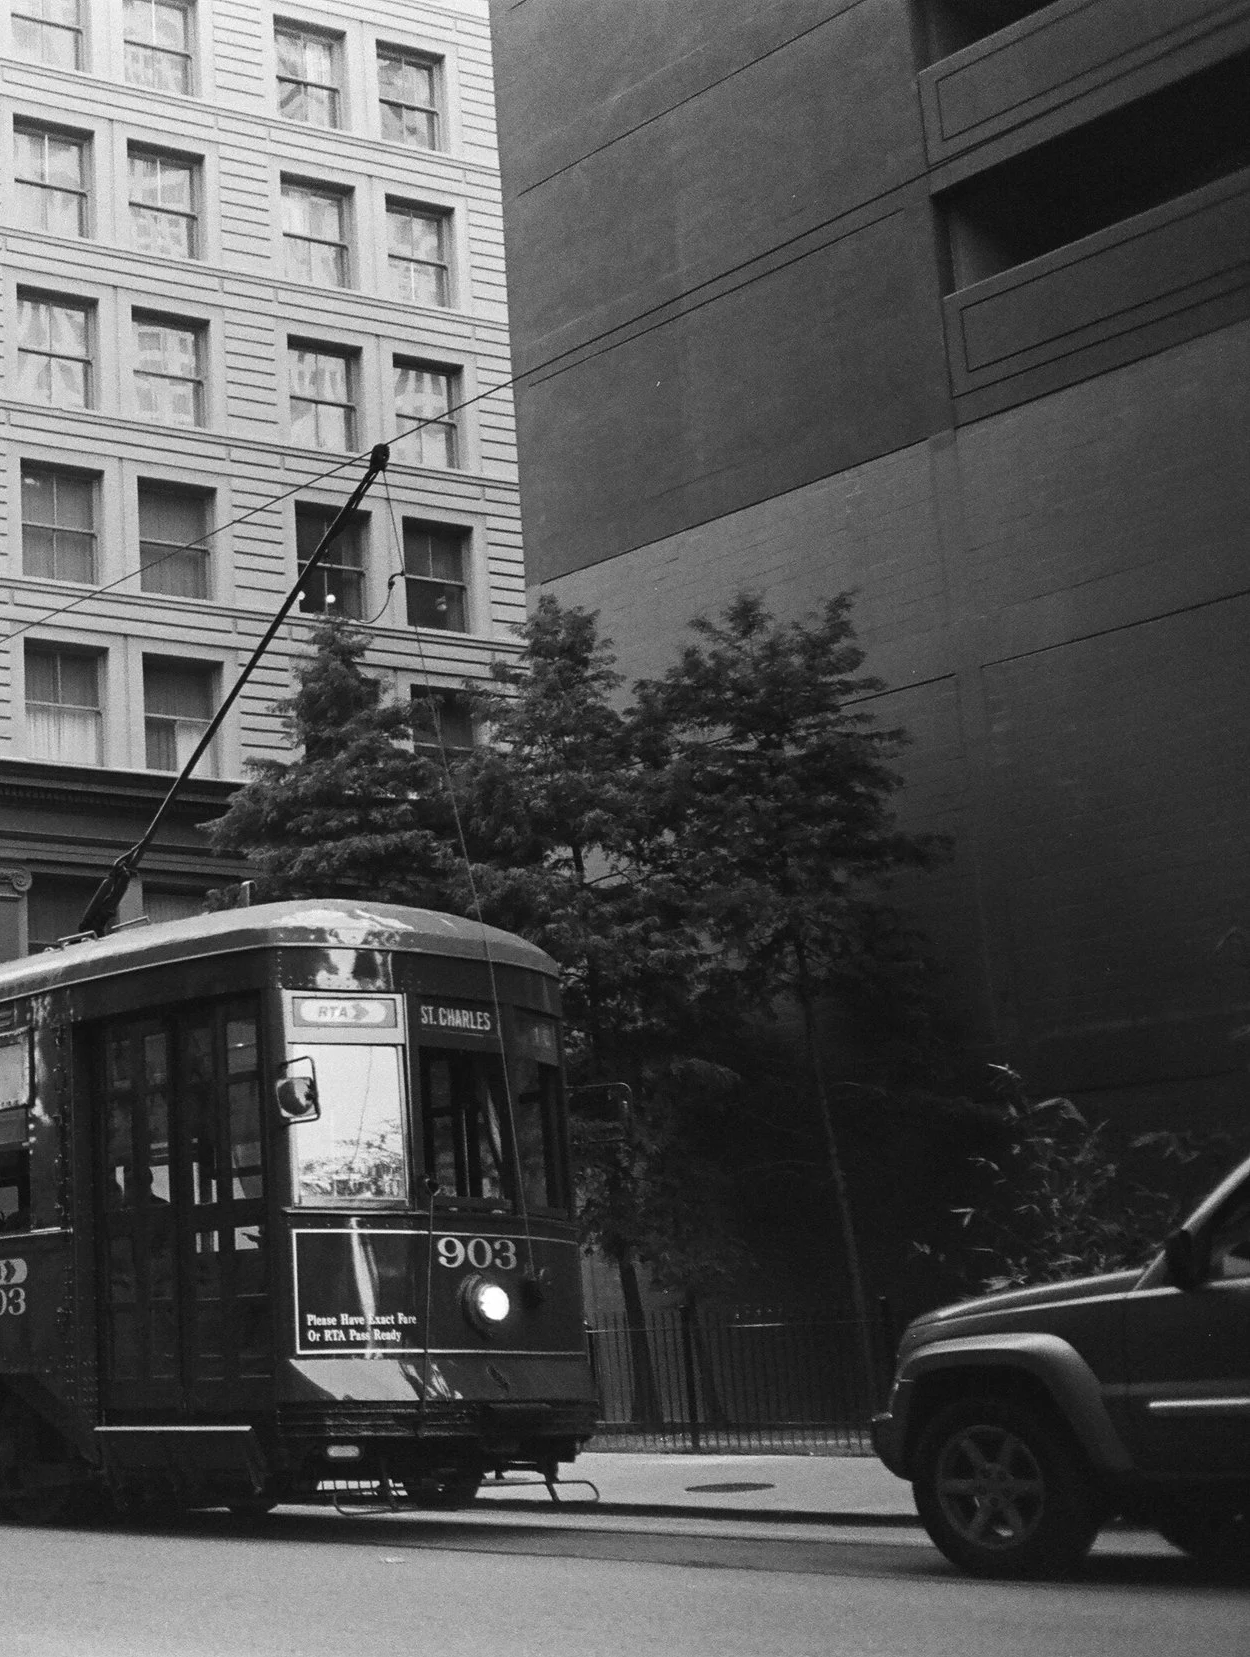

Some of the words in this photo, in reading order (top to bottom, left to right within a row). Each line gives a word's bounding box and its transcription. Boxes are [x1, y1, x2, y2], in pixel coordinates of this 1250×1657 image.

[318, 1006, 348, 1018] RTA
[420, 1005, 437, 1026] ST.
[438, 1007, 491, 1031] CHARLES
[437, 1236, 517, 1270] 903
[306, 1313, 337, 1326] Please
[340, 1313, 365, 1326] Have
[368, 1313, 395, 1325] Exact
[397, 1312, 417, 1325] Fare
[307, 1329, 321, 1342] Or
[324, 1329, 346, 1341] RTA
[349, 1328, 370, 1341] Pass
[373, 1328, 402, 1342] Ready
